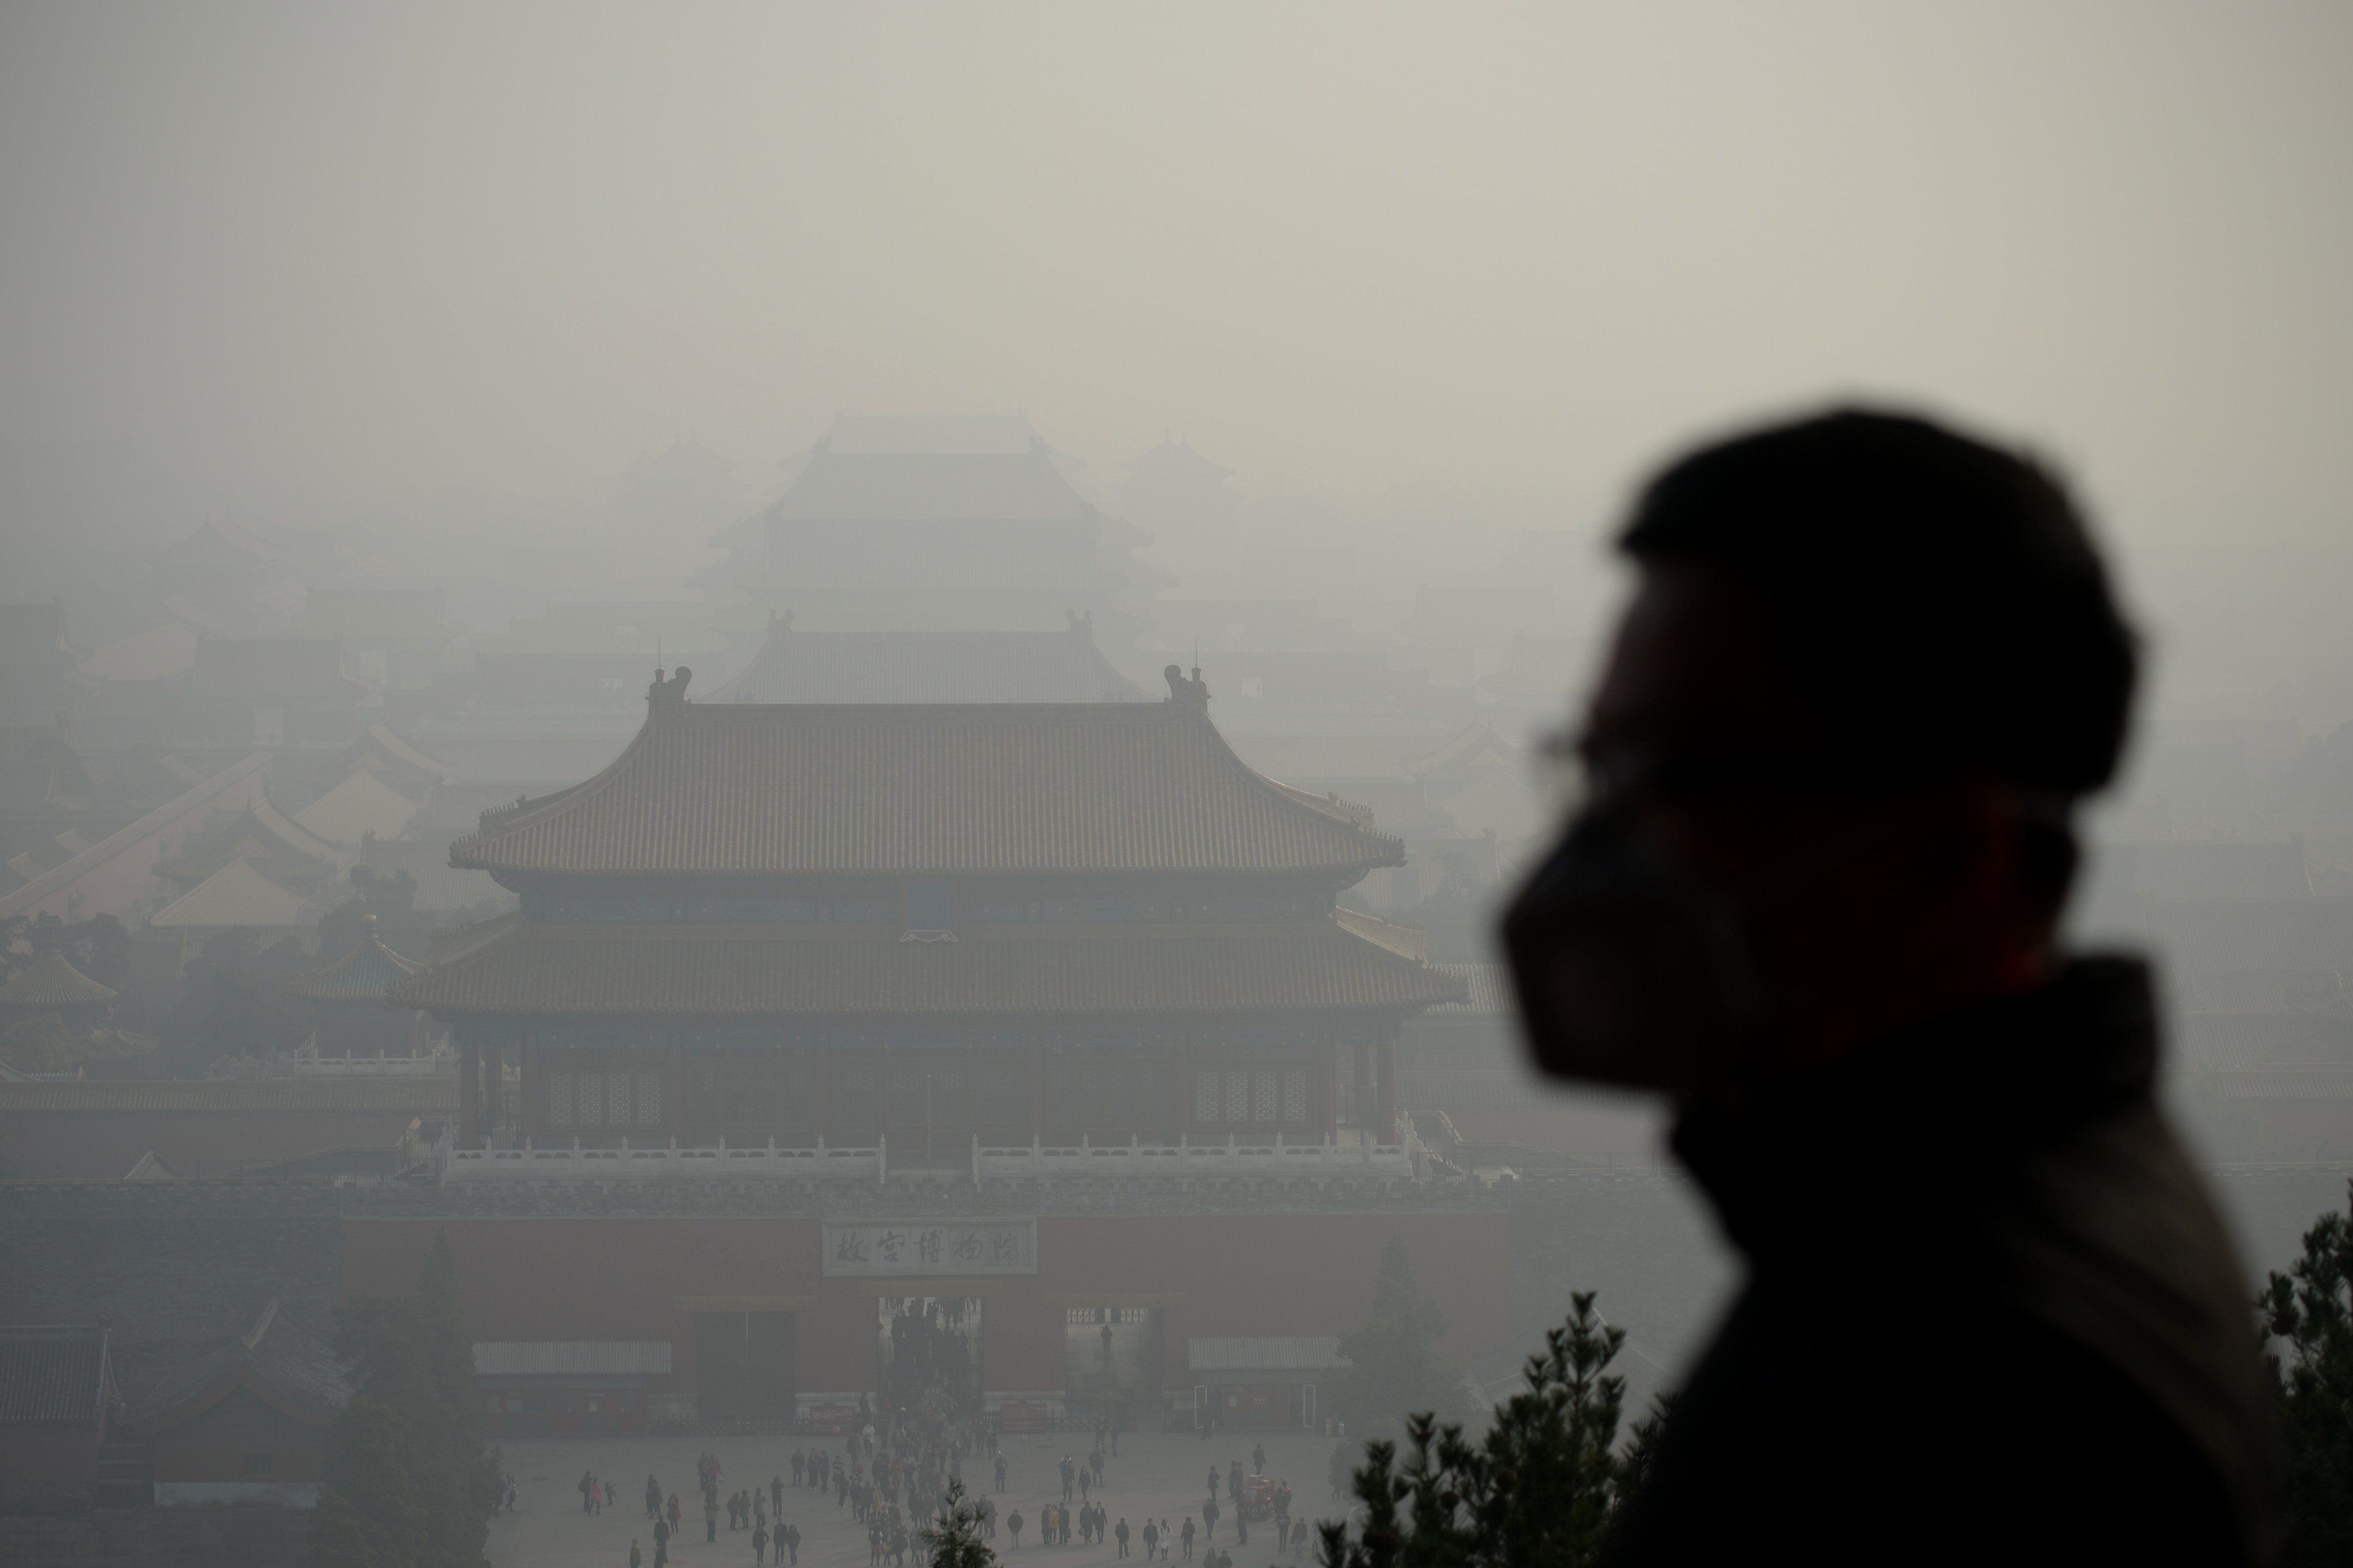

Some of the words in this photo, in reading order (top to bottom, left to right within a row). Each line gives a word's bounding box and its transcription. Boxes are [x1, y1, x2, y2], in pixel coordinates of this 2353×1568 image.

[837, 1230, 1020, 1263] 故宫博物院
